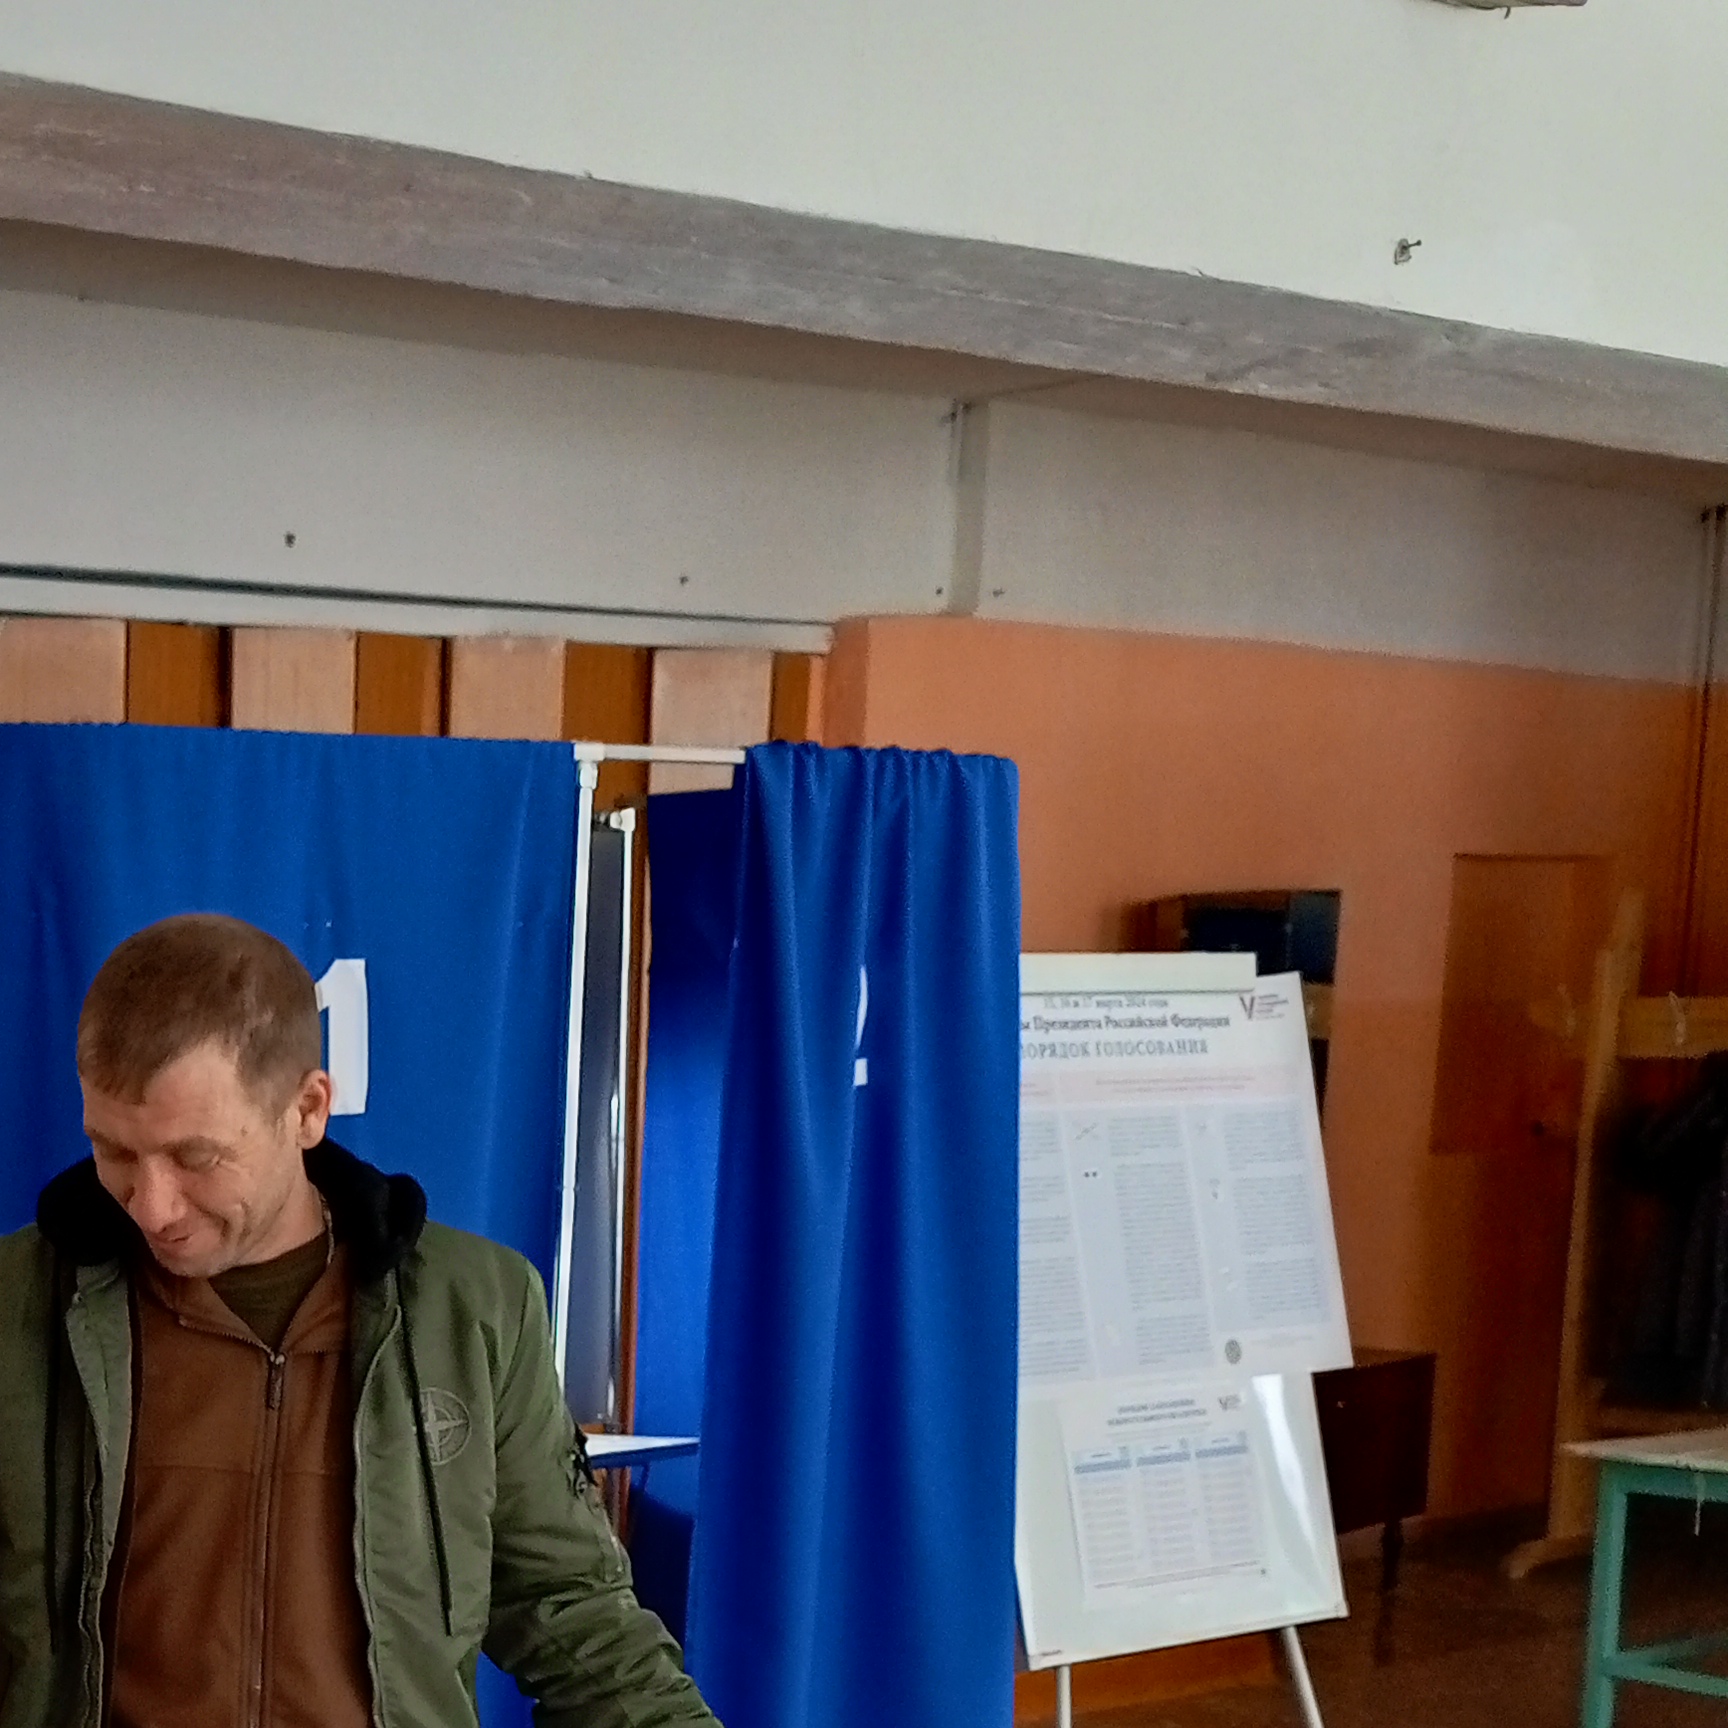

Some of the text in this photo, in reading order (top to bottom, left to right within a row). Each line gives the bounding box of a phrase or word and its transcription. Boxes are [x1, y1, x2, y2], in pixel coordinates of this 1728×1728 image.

[1033, 1015, 1103, 1034] Президента
[1104, 1014, 1169, 1029] Российской
[1170, 1013, 1231, 1031] Федерации
[314, 958, 369, 1116] 1
[1095, 1038, 1208, 1058] ГОЛОСОВАНИЯ
